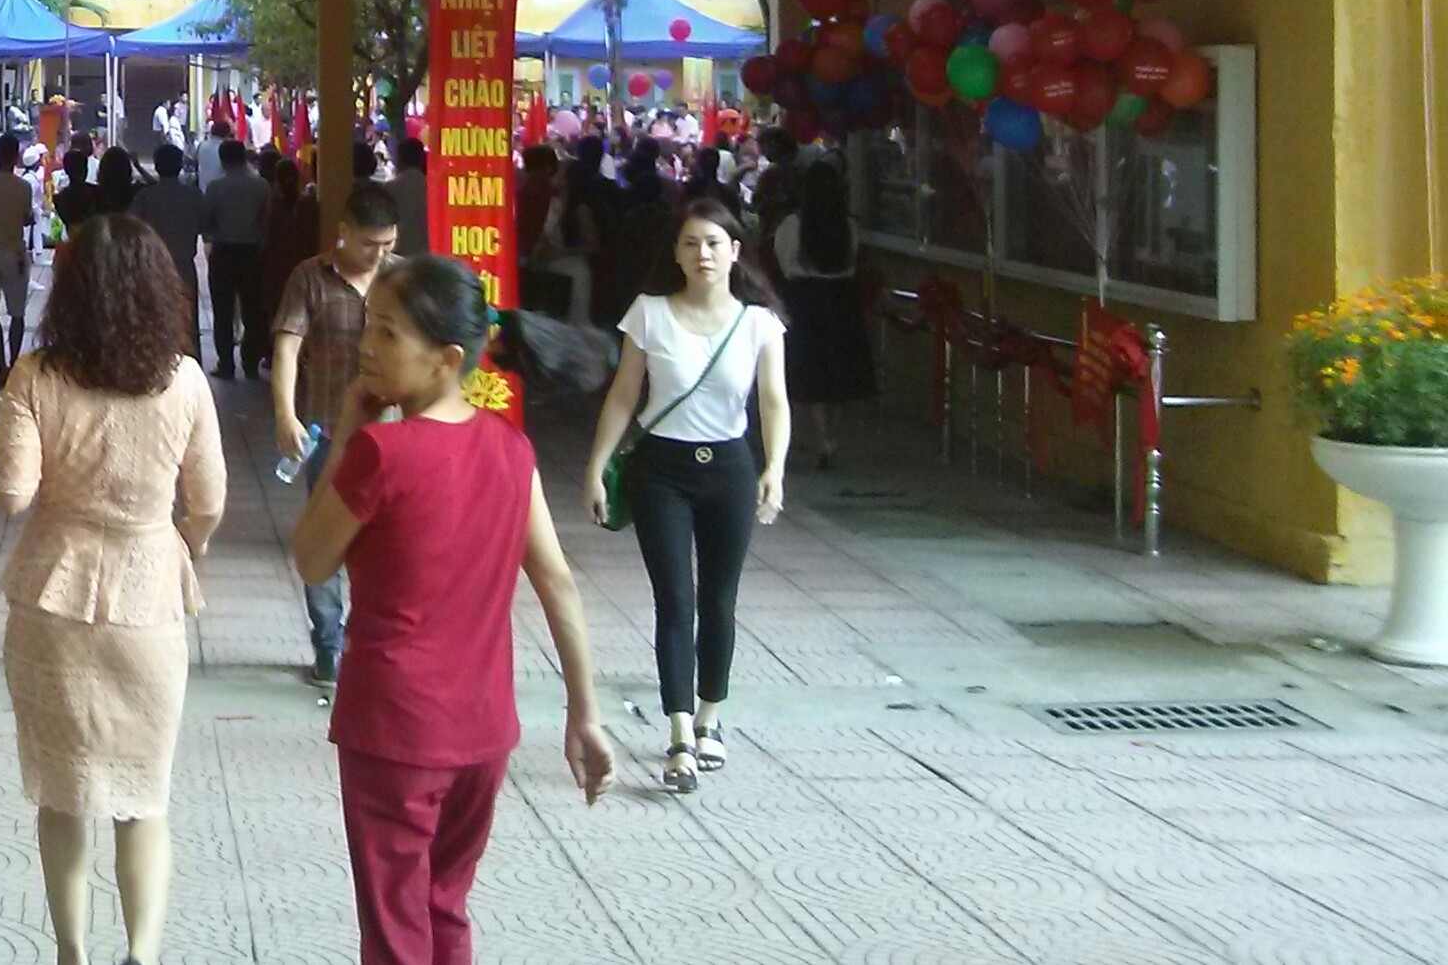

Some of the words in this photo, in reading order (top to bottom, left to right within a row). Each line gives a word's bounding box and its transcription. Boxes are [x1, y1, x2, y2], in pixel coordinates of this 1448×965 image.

[451, 24, 498, 65] LIỆT
[444, 73, 505, 108] CHÀO
[440, 122, 509, 157] MỪNG
[448, 171, 505, 206] NĂM
[452, 225, 501, 262] HỌC
